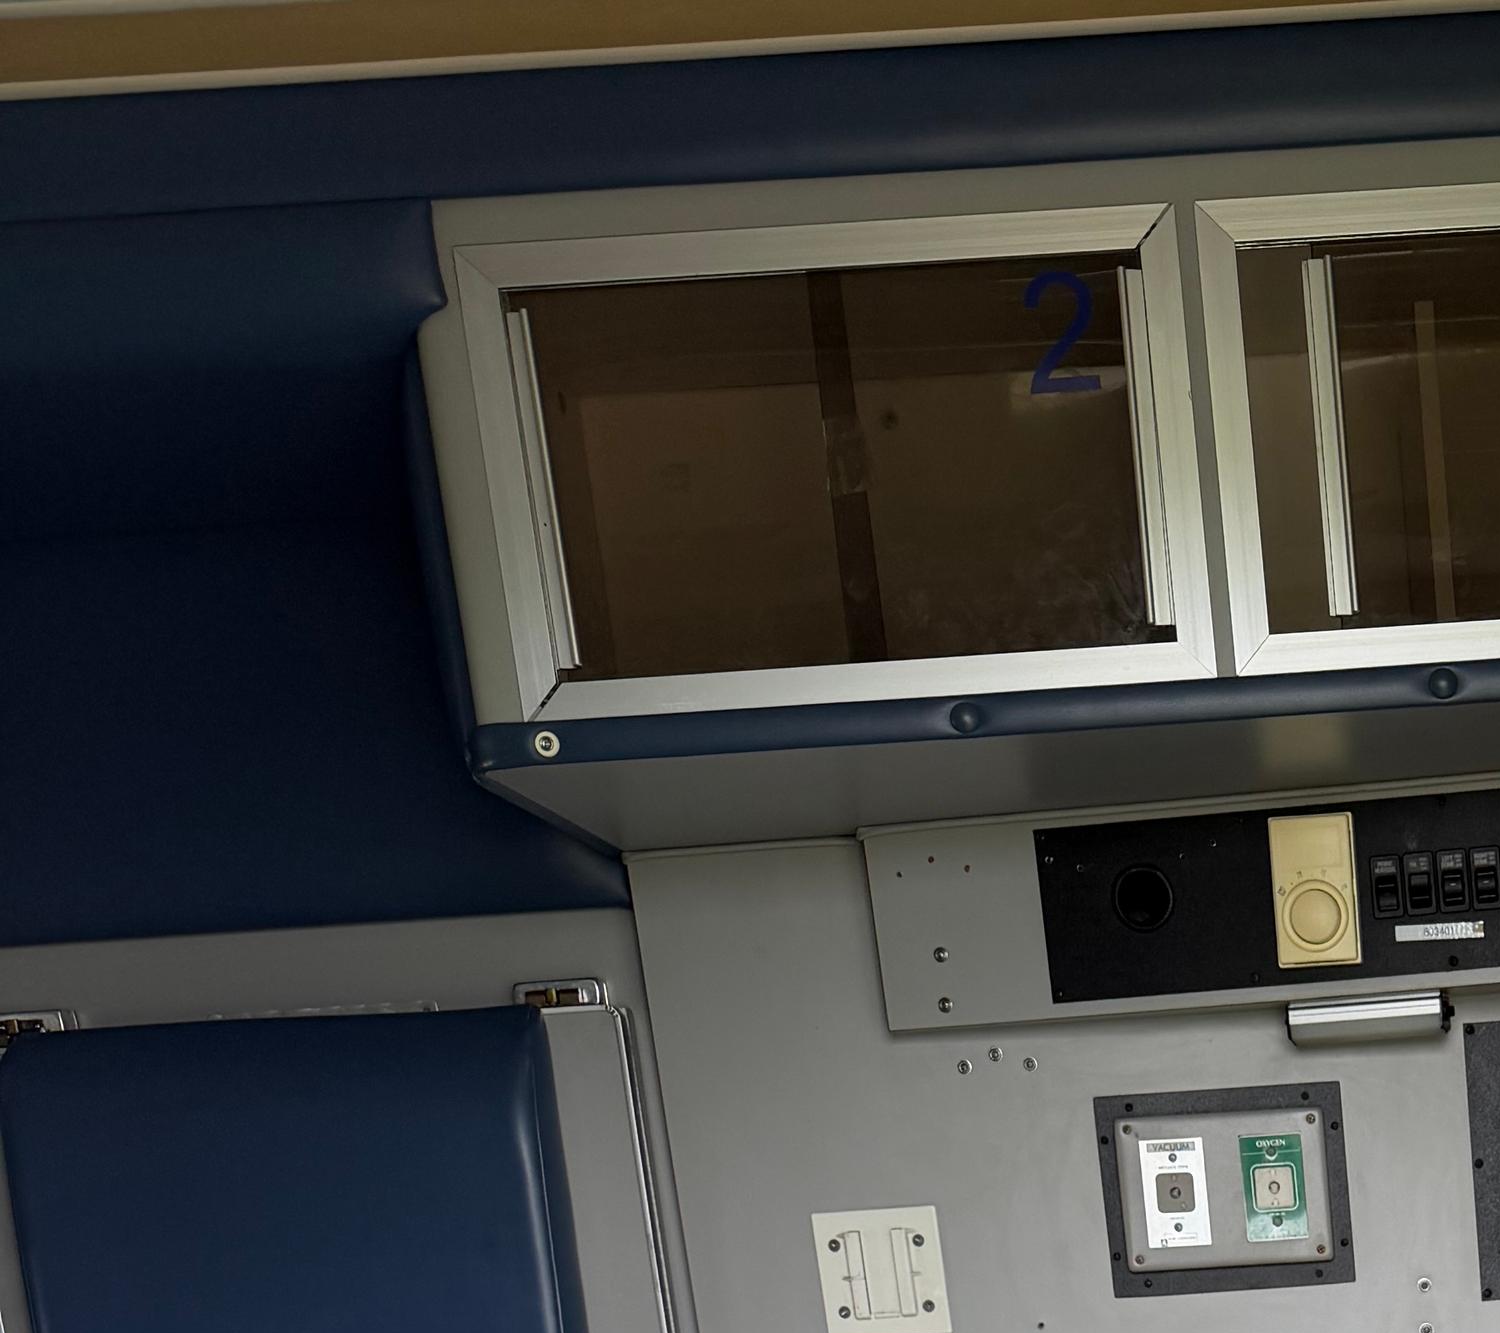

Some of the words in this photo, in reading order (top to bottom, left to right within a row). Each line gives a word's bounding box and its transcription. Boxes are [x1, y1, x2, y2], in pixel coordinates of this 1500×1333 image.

[1023, 270, 1102, 395] 2
[1152, 1142, 1190, 1151] VACUUM
[1255, 1139, 1286, 1148] OXYGEN
